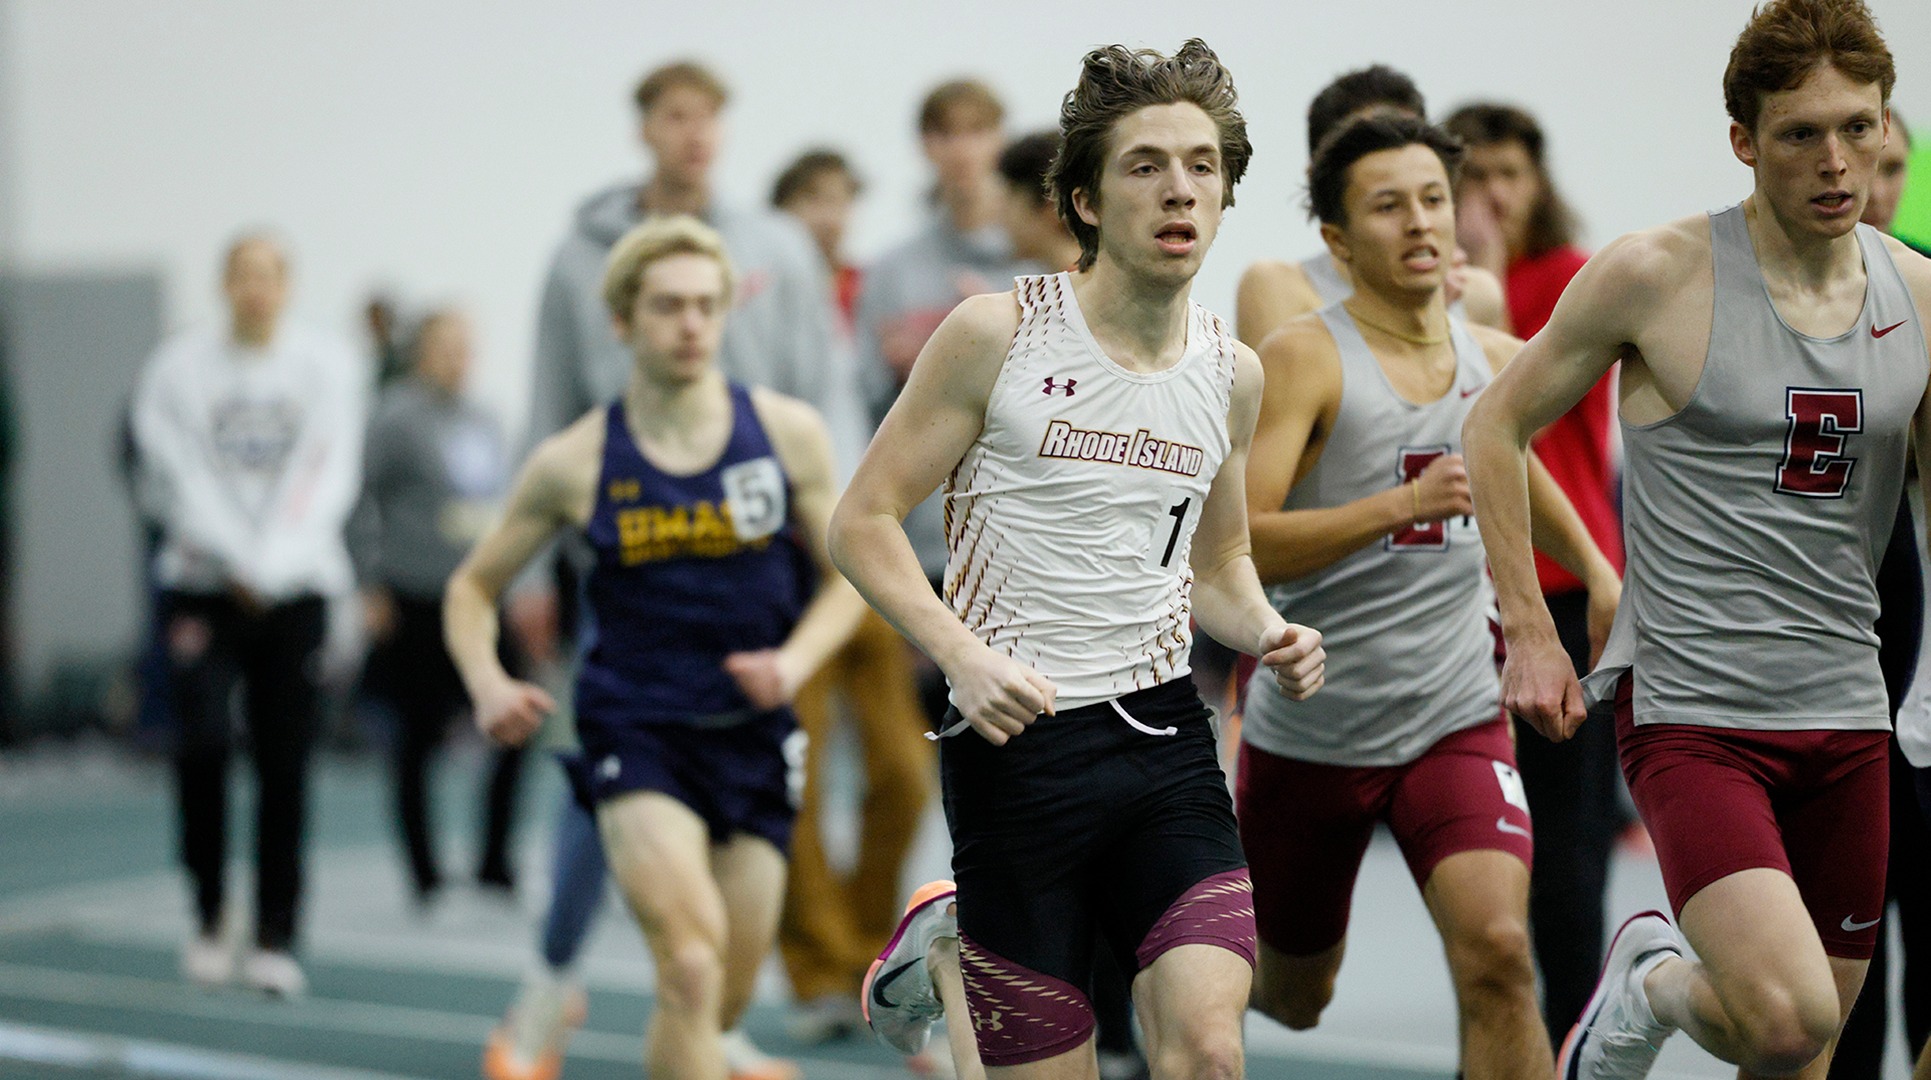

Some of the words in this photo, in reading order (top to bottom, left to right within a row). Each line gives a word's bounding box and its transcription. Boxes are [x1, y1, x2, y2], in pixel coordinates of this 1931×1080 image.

[1038, 419, 1132, 465] RHODE
[1127, 427, 1204, 478] ISLAND
[1772, 386, 1864, 499] E
[738, 473, 774, 525] 5
[1160, 496, 1192, 568] 1
